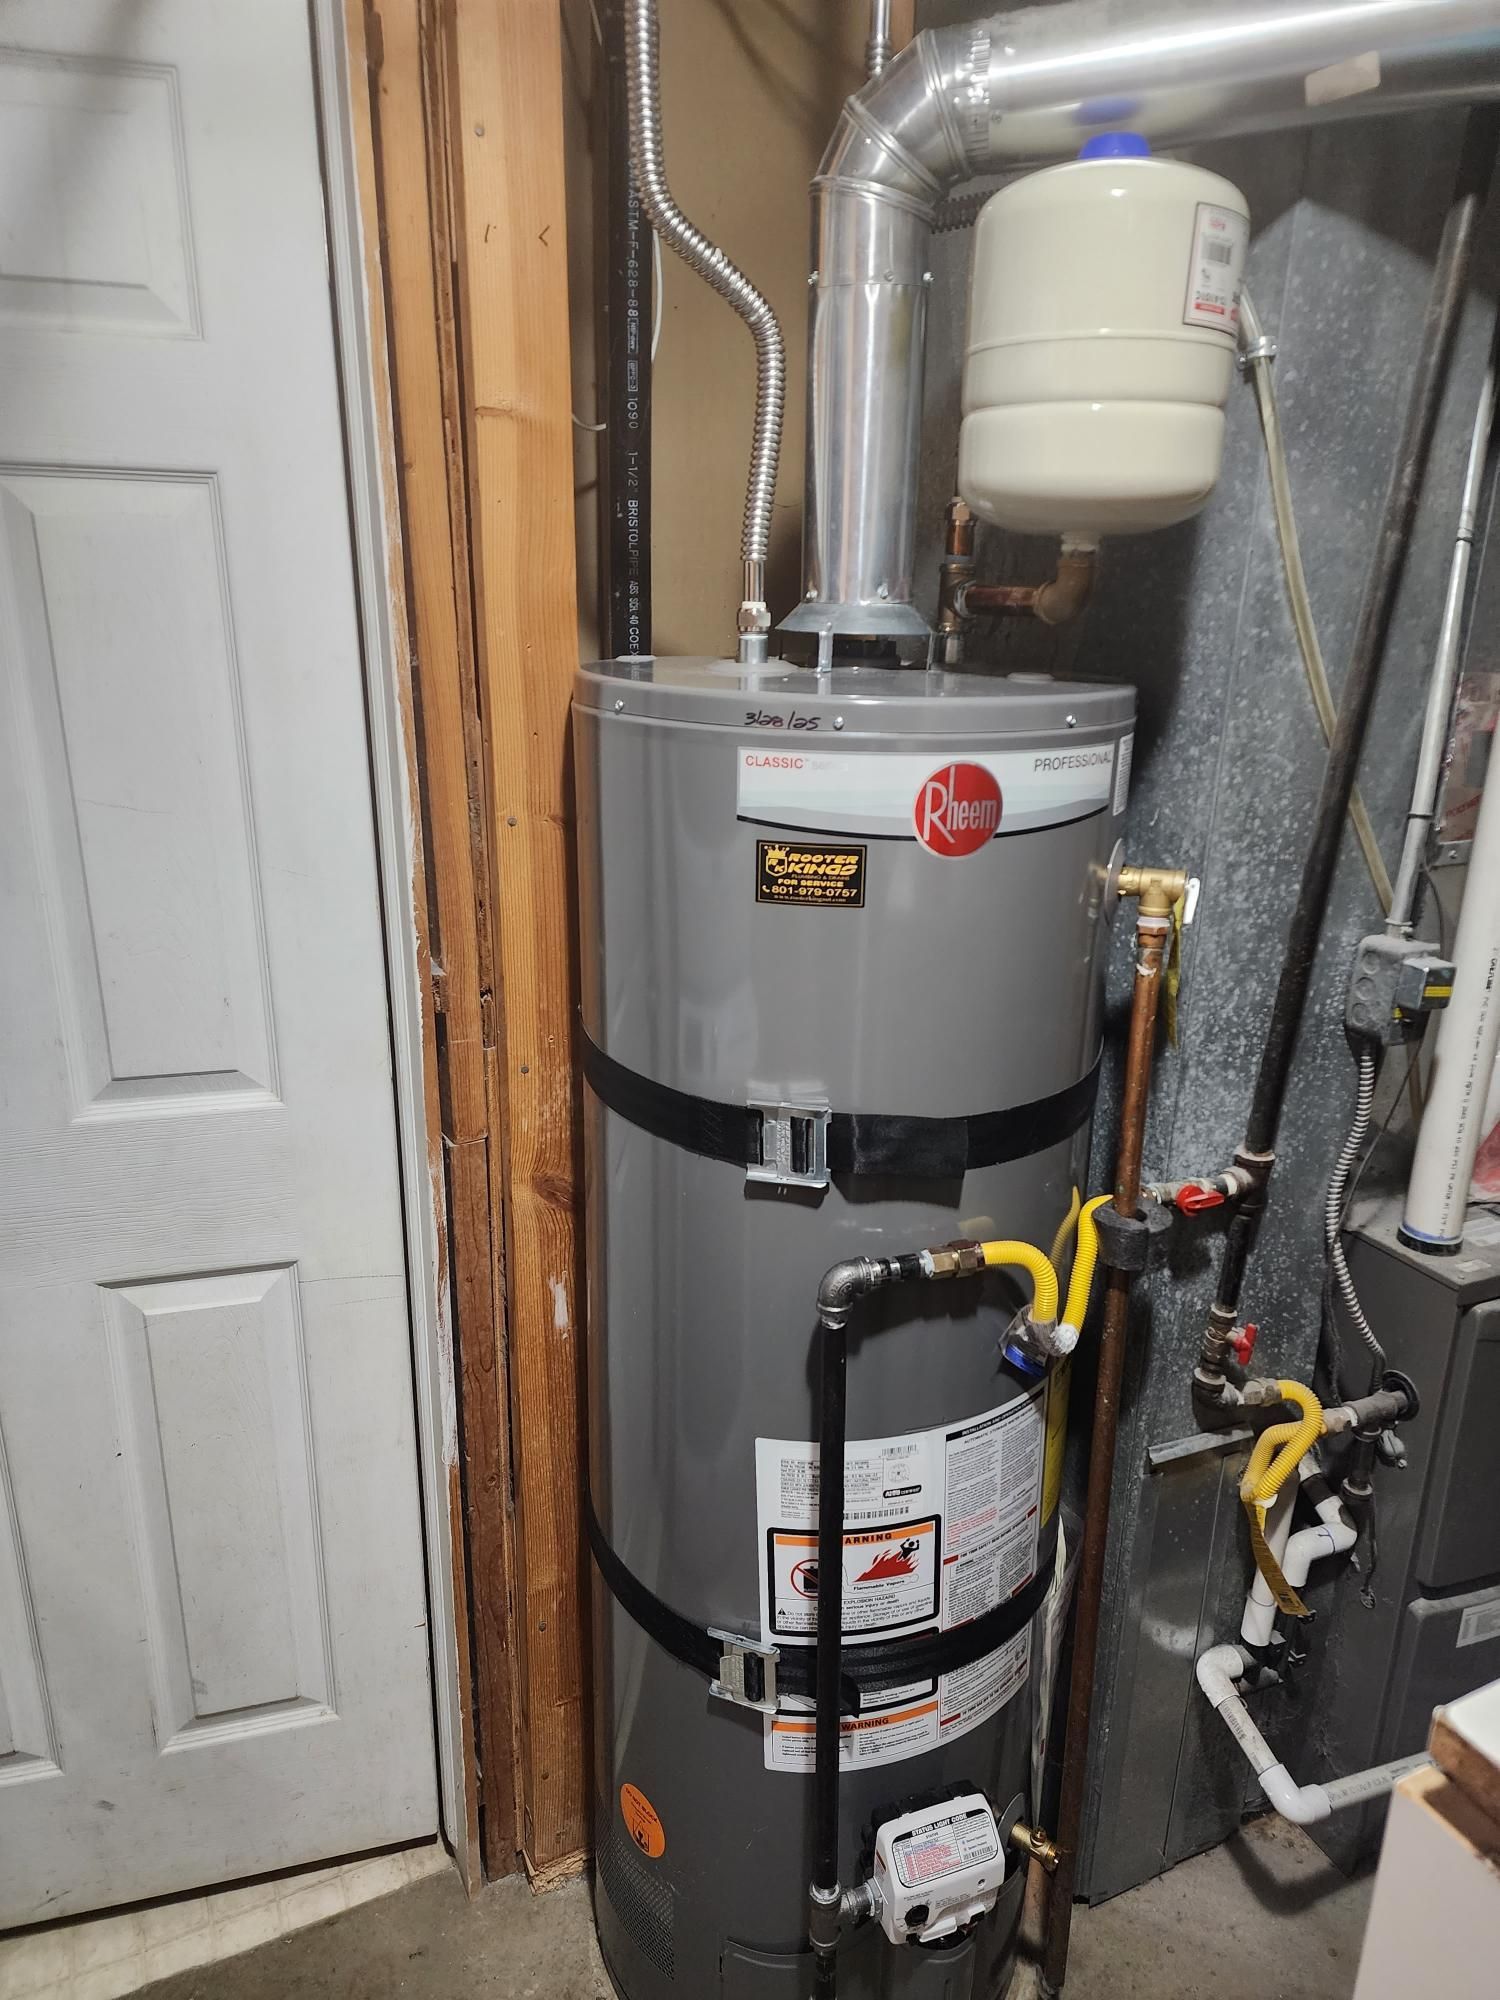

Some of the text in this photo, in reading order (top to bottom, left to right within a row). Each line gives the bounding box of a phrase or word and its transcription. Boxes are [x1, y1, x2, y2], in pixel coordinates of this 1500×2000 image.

[627, 394, 639, 429] 1090
[628, 580, 639, 595] ABS
[628, 615, 639, 625] 40
[744, 710, 821, 731] 3/28/25
[745, 755, 804, 769] CLASSIC
[1034, 751, 1112, 772] PROFESSIONAL
[923, 765, 997, 844] Rheem
[788, 853, 859, 864] ROOTER
[787, 863, 858, 875] KINGS
[800, 879, 844, 887] SERVICE
[771, 885, 858, 897] 801-979-0757
[845, 1533, 892, 1545] ARNING
[853, 1583, 884, 1591] Flammable
[841, 1718, 889, 1731] WARNING
[911, 1824, 934, 1837] STATUS
[933, 1818, 951, 1829] LIGHT
[951, 1812, 967, 1823] CODE
